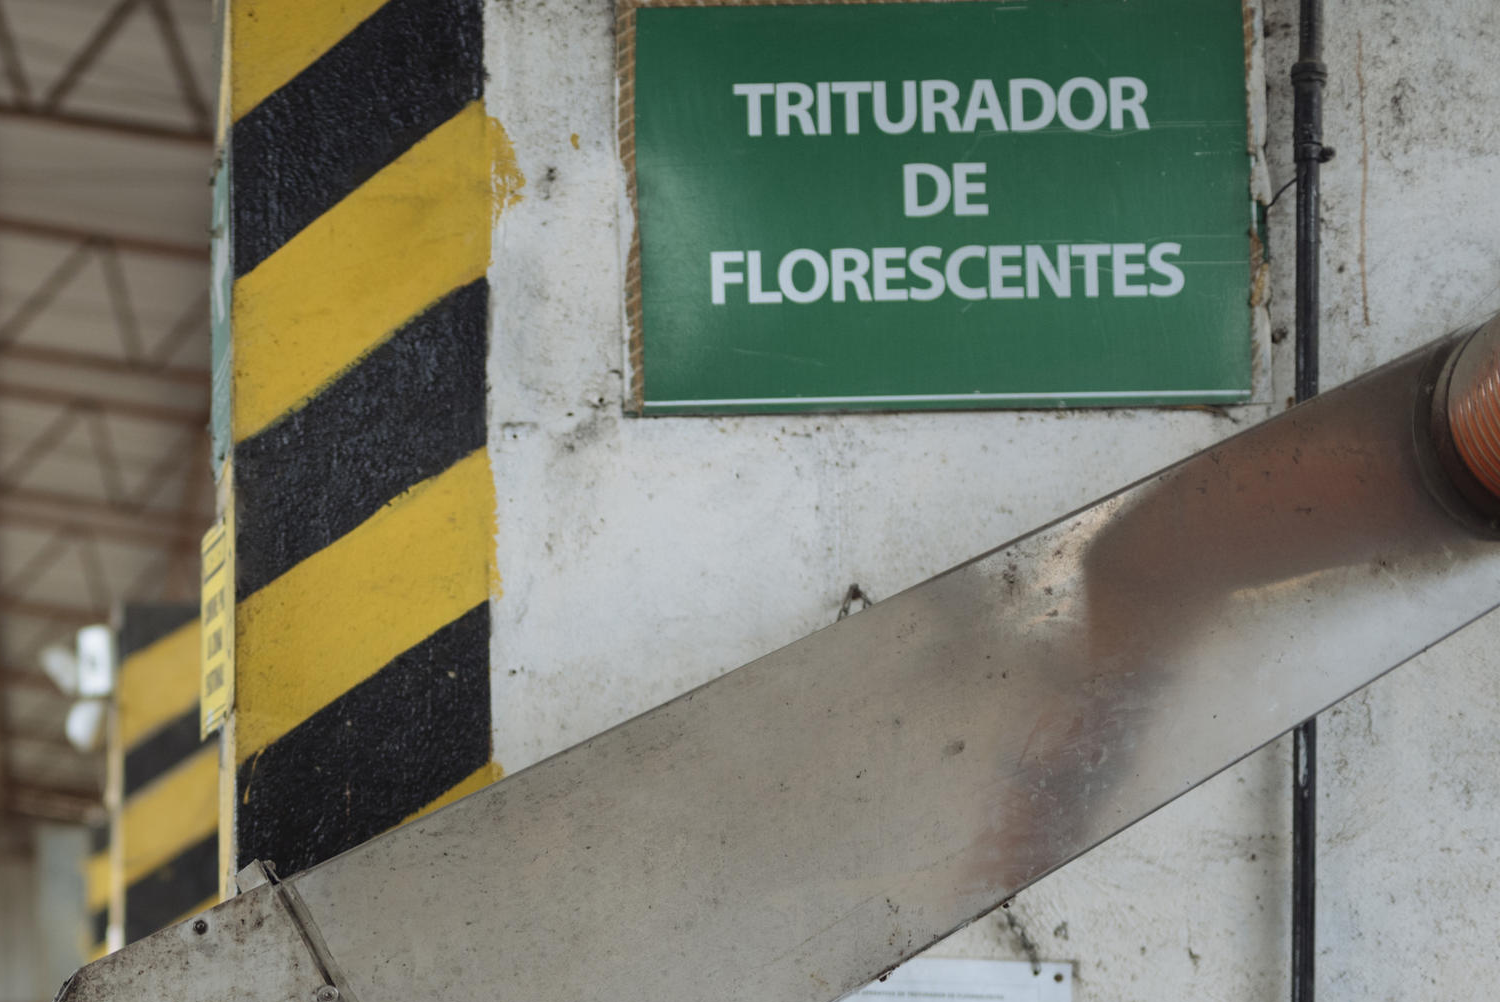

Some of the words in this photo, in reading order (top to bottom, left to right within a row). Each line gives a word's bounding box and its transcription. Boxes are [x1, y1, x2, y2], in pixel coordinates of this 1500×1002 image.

[733, 76, 1150, 136] TRITURADOR
[903, 162, 989, 218] DE
[710, 242, 1185, 304] FLORESCENTES
